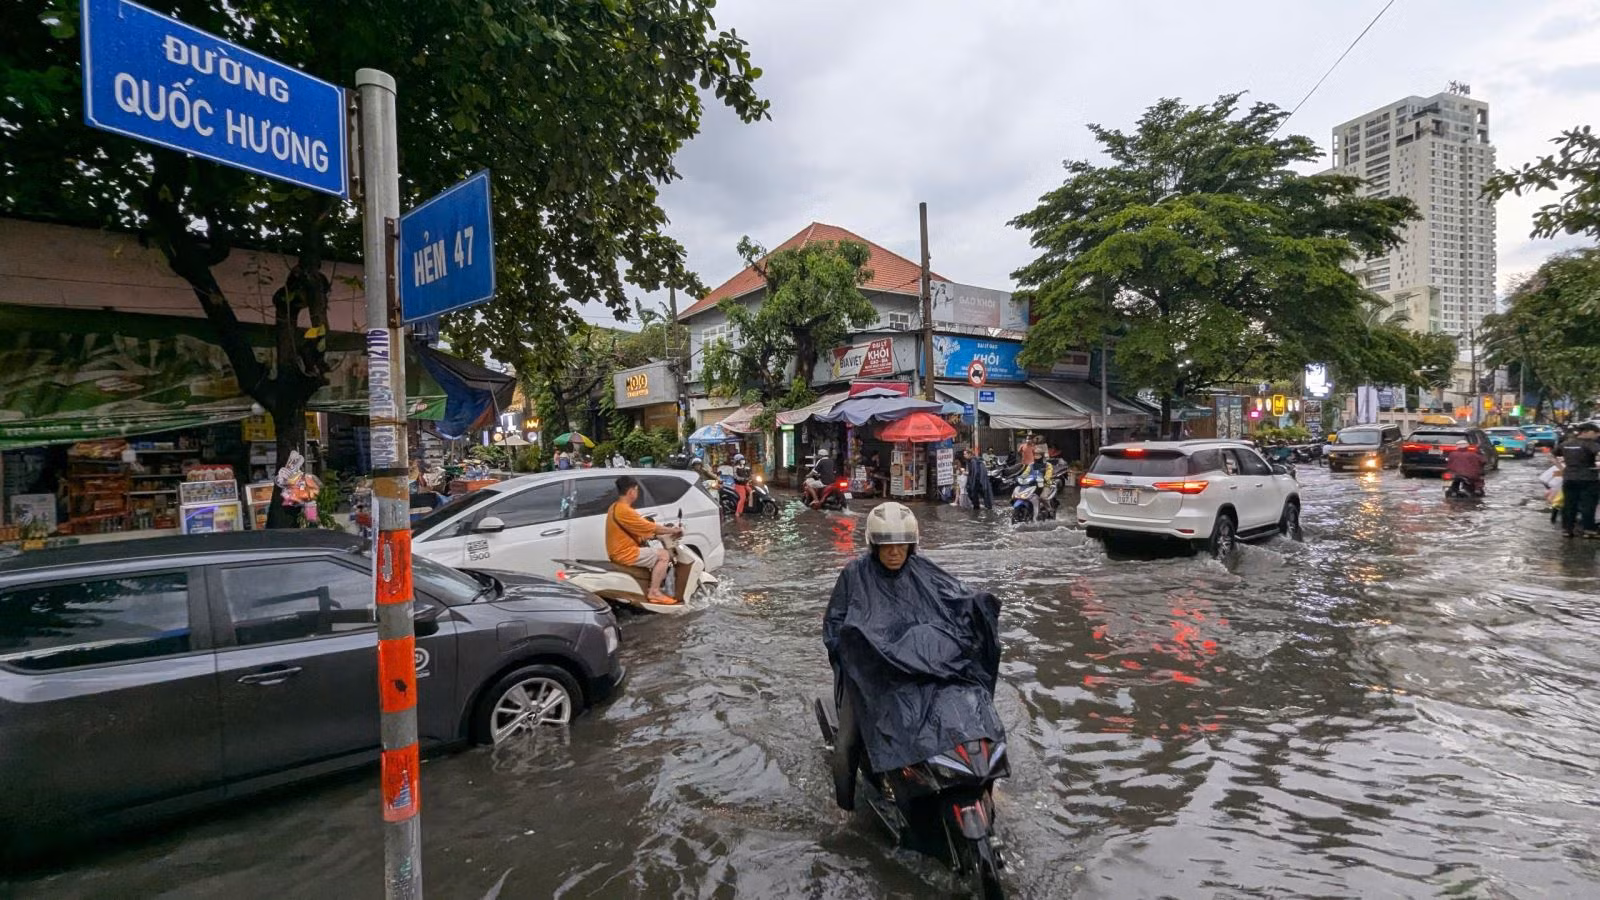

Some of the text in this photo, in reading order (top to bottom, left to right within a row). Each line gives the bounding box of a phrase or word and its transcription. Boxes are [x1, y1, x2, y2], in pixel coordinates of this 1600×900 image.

[162, 34, 290, 103] ĐƯỜNG
[114, 72, 329, 173] QUỐC HƯƠNG
[414, 226, 474, 287] HẺM 47
[868, 347, 889, 360] KHÔI
[973, 352, 999, 366] KHÔI
